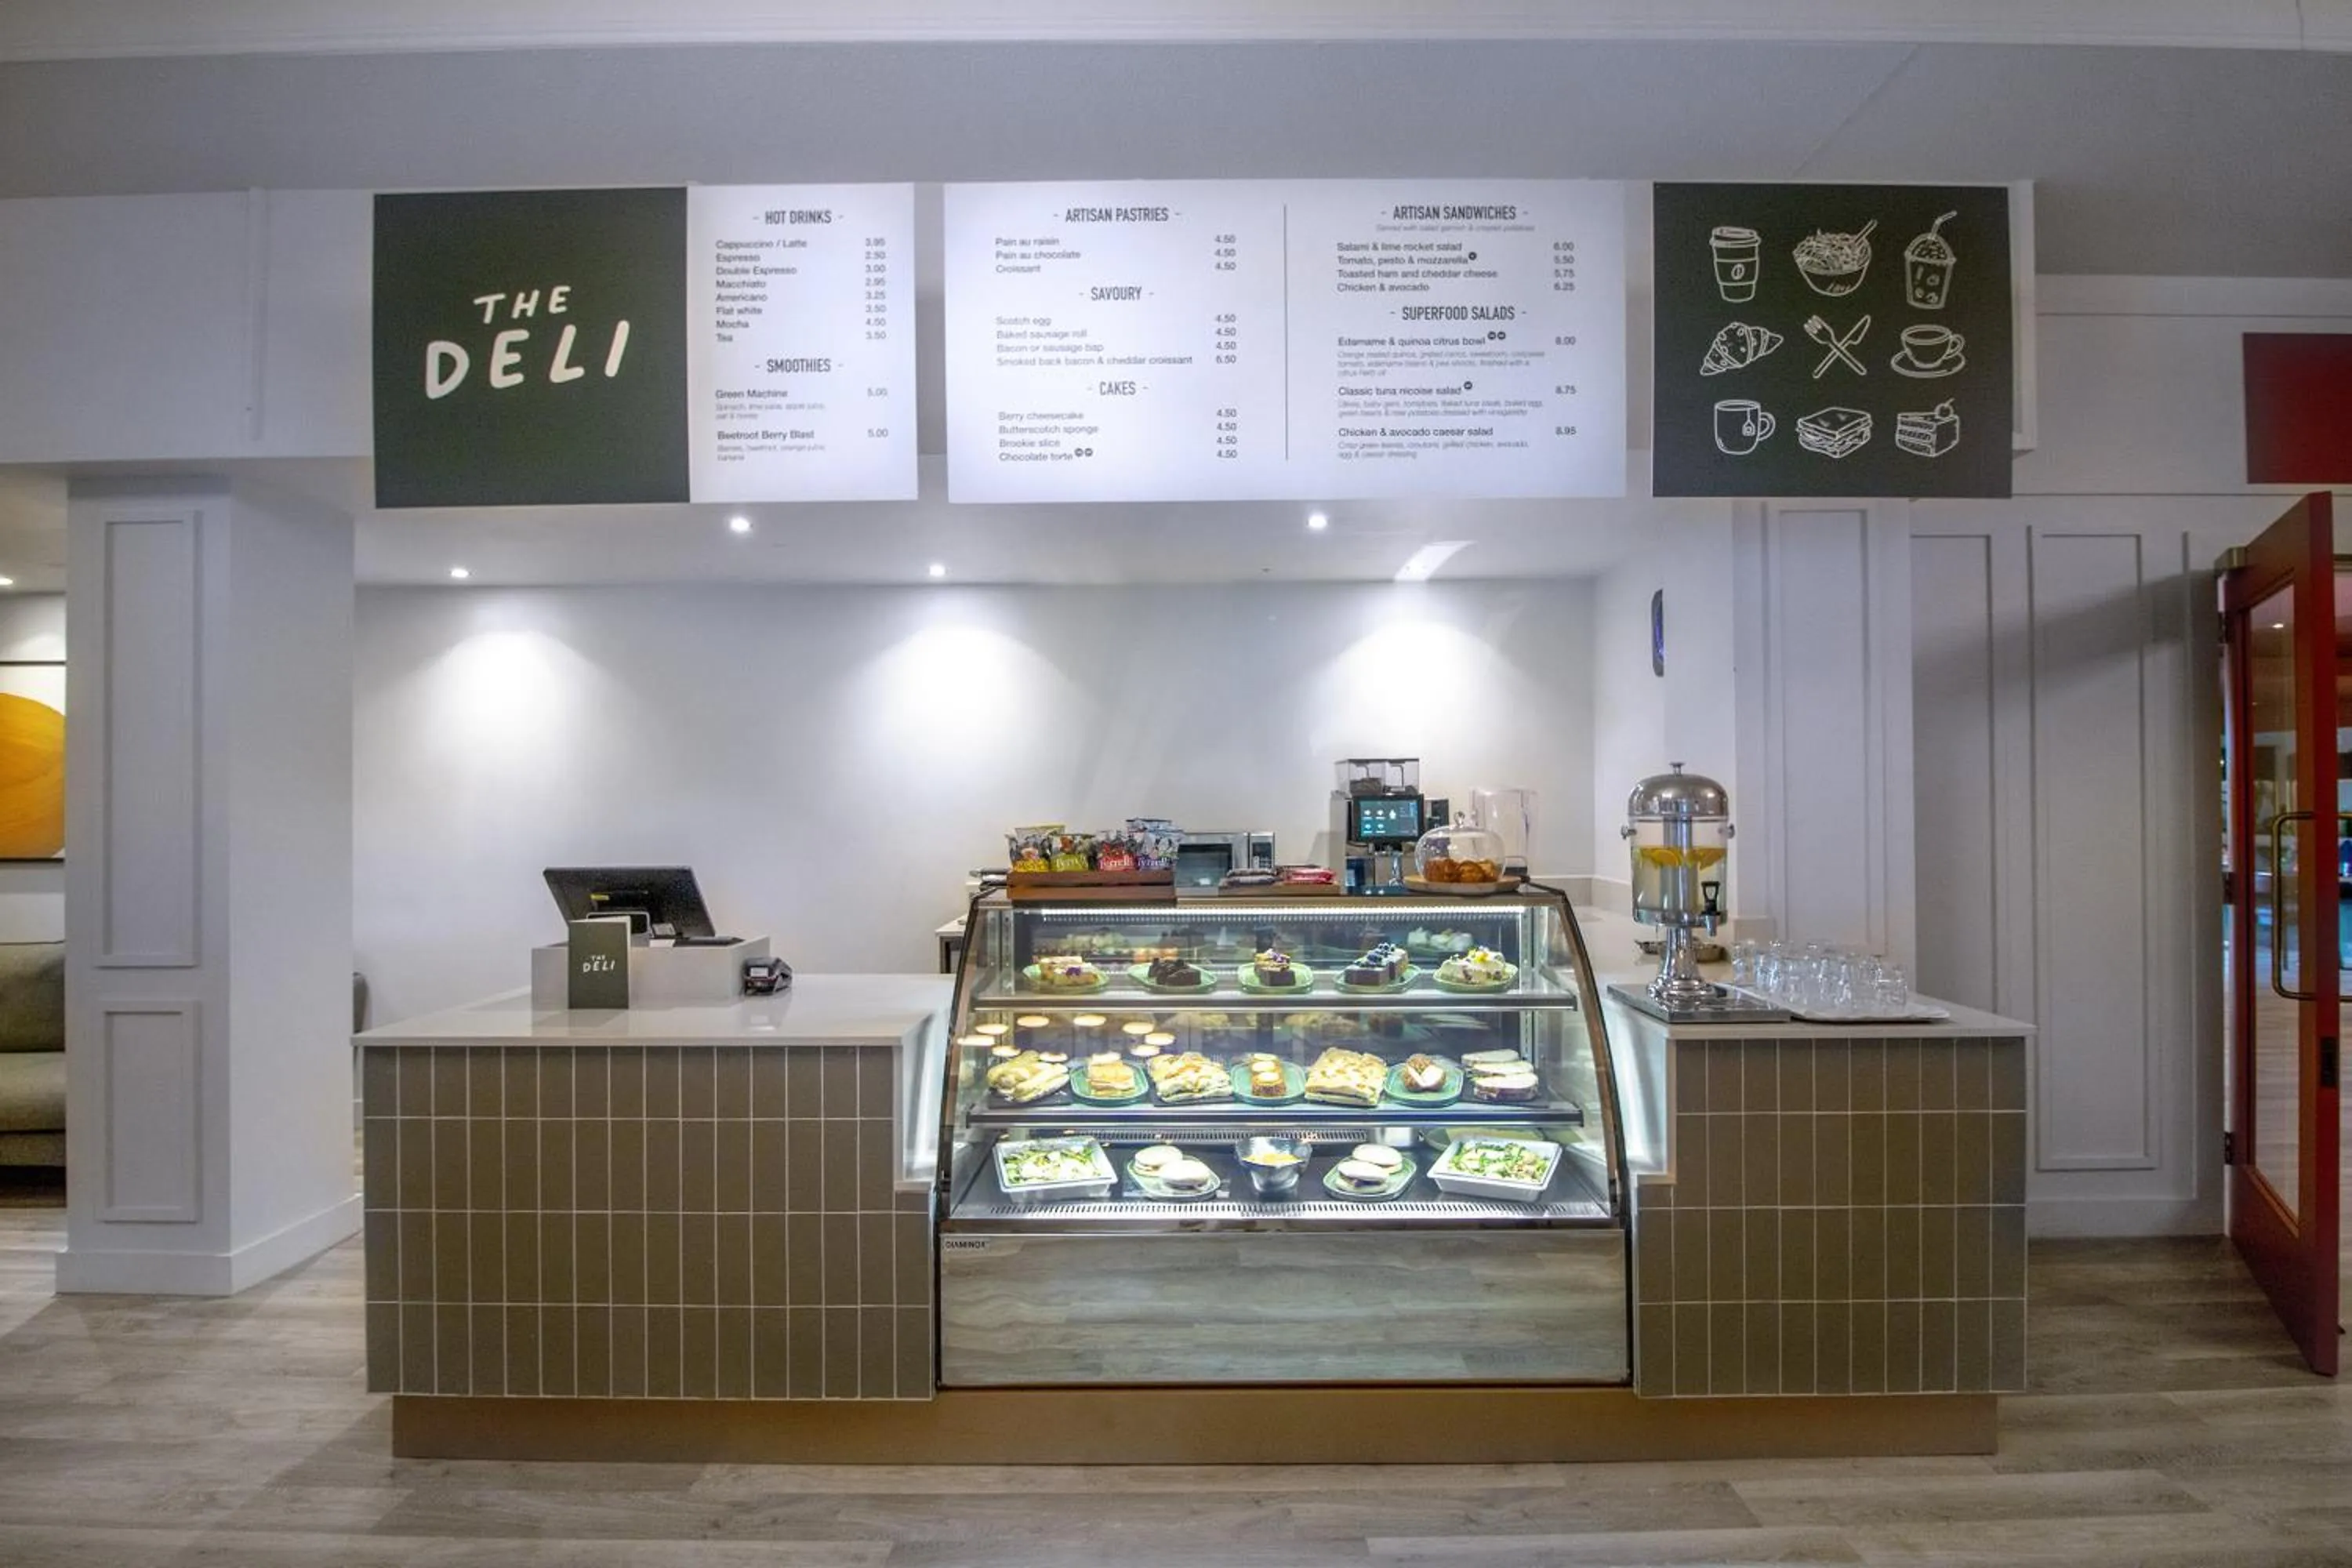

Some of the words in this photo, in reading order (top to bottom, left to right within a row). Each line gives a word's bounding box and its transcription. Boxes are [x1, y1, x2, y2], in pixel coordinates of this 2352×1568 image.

[765, 210, 786, 224] HOT
[789, 209, 832, 224] DRINKS
[1065, 208, 1112, 223] ARTISAN
[1116, 207, 1169, 222] PASTRIES
[1393, 205, 1440, 220] ARTISAN
[1443, 205, 1516, 220] SANDWICHES
[995, 238, 1017, 246] Pain
[1033, 238, 1060, 246] raisin
[1214, 234, 1236, 244] 4.50
[715, 240, 774, 250] Cappuccino
[782, 239, 808, 248] Latte
[1337, 242, 1370, 252] Salami
[1371, 241, 1379, 251] &
[1381, 242, 1402, 251] lime
[1403, 242, 1434, 252] rocket
[1436, 242, 1462, 252] salad
[715, 252, 760, 263] Espresso
[995, 250, 1017, 260] Pain
[1033, 250, 1081, 260] chocolate
[1214, 248, 1236, 258] 4.50
[1214, 261, 1236, 270] 4.50
[1338, 256, 1376, 266] Tomato,
[1377, 256, 1406, 267] pesto
[1407, 255, 1415, 264] &
[1417, 255, 1468, 265] mozzarella
[716, 267, 750, 275] Double
[753, 265, 797, 276] Espresso
[996, 264, 1041, 274] Croissant
[1337, 269, 1376, 278] Toasted
[1377, 270, 1399, 278] ham
[1401, 269, 1420, 278] and
[1421, 270, 1461, 278] cheddar
[1463, 269, 1498, 278] cheese
[716, 280, 767, 289] Macchiato
[1337, 283, 1377, 292] Chicken
[1378, 282, 1386, 292] &
[1388, 282, 1430, 292] avocado
[715, 293, 768, 302] Americano
[1091, 286, 1142, 301] SAVOURY
[474, 285, 572, 324] THE
[716, 307, 735, 315] Flat
[736, 307, 763, 315] white
[1402, 306, 1468, 321] SUPERFOOD
[1471, 306, 1515, 321] SALADS
[996, 316, 1030, 325] Scotch
[1032, 318, 1052, 327] egg
[1215, 314, 1236, 323] 4.50
[716, 320, 750, 328] Mocha
[996, 330, 1028, 339] Baked
[1029, 331, 1070, 340] sausage
[1072, 329, 1087, 338] roll
[1215, 327, 1236, 336] 4.50
[716, 332, 733, 342] Tea
[1338, 336, 1387, 347] Edamame
[1388, 336, 1396, 346] &
[1398, 338, 1431, 347] quinoa
[1432, 337, 1460, 346] citrus
[1462, 337, 1486, 346] bowl
[996, 343, 1028, 353] Bacon
[1043, 344, 1083, 354] sausage
[1084, 343, 1105, 353] bap
[1216, 341, 1236, 350] 4.50
[426, 319, 630, 399] DELI
[996, 358, 1036, 366] Smoked
[1065, 357, 1095, 365] bacon
[1097, 356, 1104, 365] &
[1106, 356, 1146, 365] cheddar
[1149, 356, 1192, 365] croissant
[767, 358, 831, 373] SMOOTHIES
[867, 387, 888, 397] 5.00
[1099, 381, 1136, 396] CAKES
[1338, 387, 1373, 396] Classic
[1436, 386, 1462, 395] salad
[715, 390, 745, 399] Green
[746, 389, 788, 399] Machine
[998, 412, 1025, 422] Berry
[1026, 412, 1084, 420] cheesecake
[1216, 408, 1237, 418] 4.50
[998, 425, 1061, 434] Butterscotch
[1062, 426, 1099, 435] sponge
[1217, 422, 1237, 431] 4.50
[717, 430, 759, 440] Beetroot
[761, 430, 788, 441] Berry
[789, 430, 815, 439] Blast
[867, 428, 888, 437] 5.00
[1338, 428, 1377, 437] Chicken
[1379, 427, 1387, 437] &
[1388, 427, 1431, 437] avocado
[1467, 427, 1494, 436] salad
[999, 438, 1036, 448] Brookie
[1038, 438, 1061, 448] slice
[1217, 435, 1238, 445] 4.50
[998, 452, 1048, 462] Chocolate
[1050, 452, 1073, 461] torte
[1217, 449, 1238, 459] 4.50
[583, 960, 615, 973] DELI
